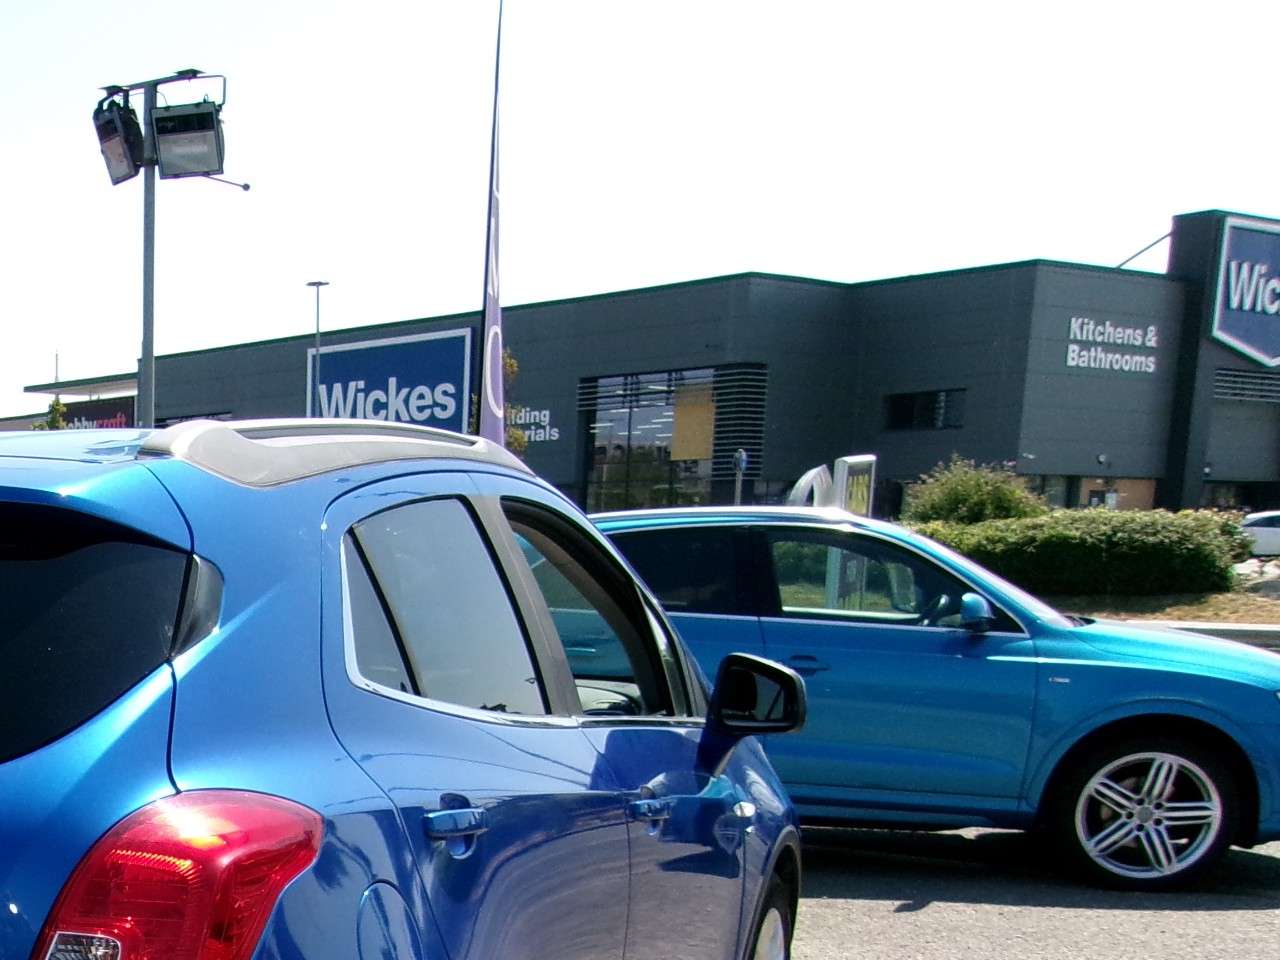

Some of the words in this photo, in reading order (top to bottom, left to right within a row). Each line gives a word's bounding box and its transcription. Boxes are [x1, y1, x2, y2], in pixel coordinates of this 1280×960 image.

[1070, 317, 1144, 346] Kitchens
[1145, 325, 1158, 348] &
[1067, 343, 1156, 373] Bathrooms
[318, 376, 457, 422] Wickes
